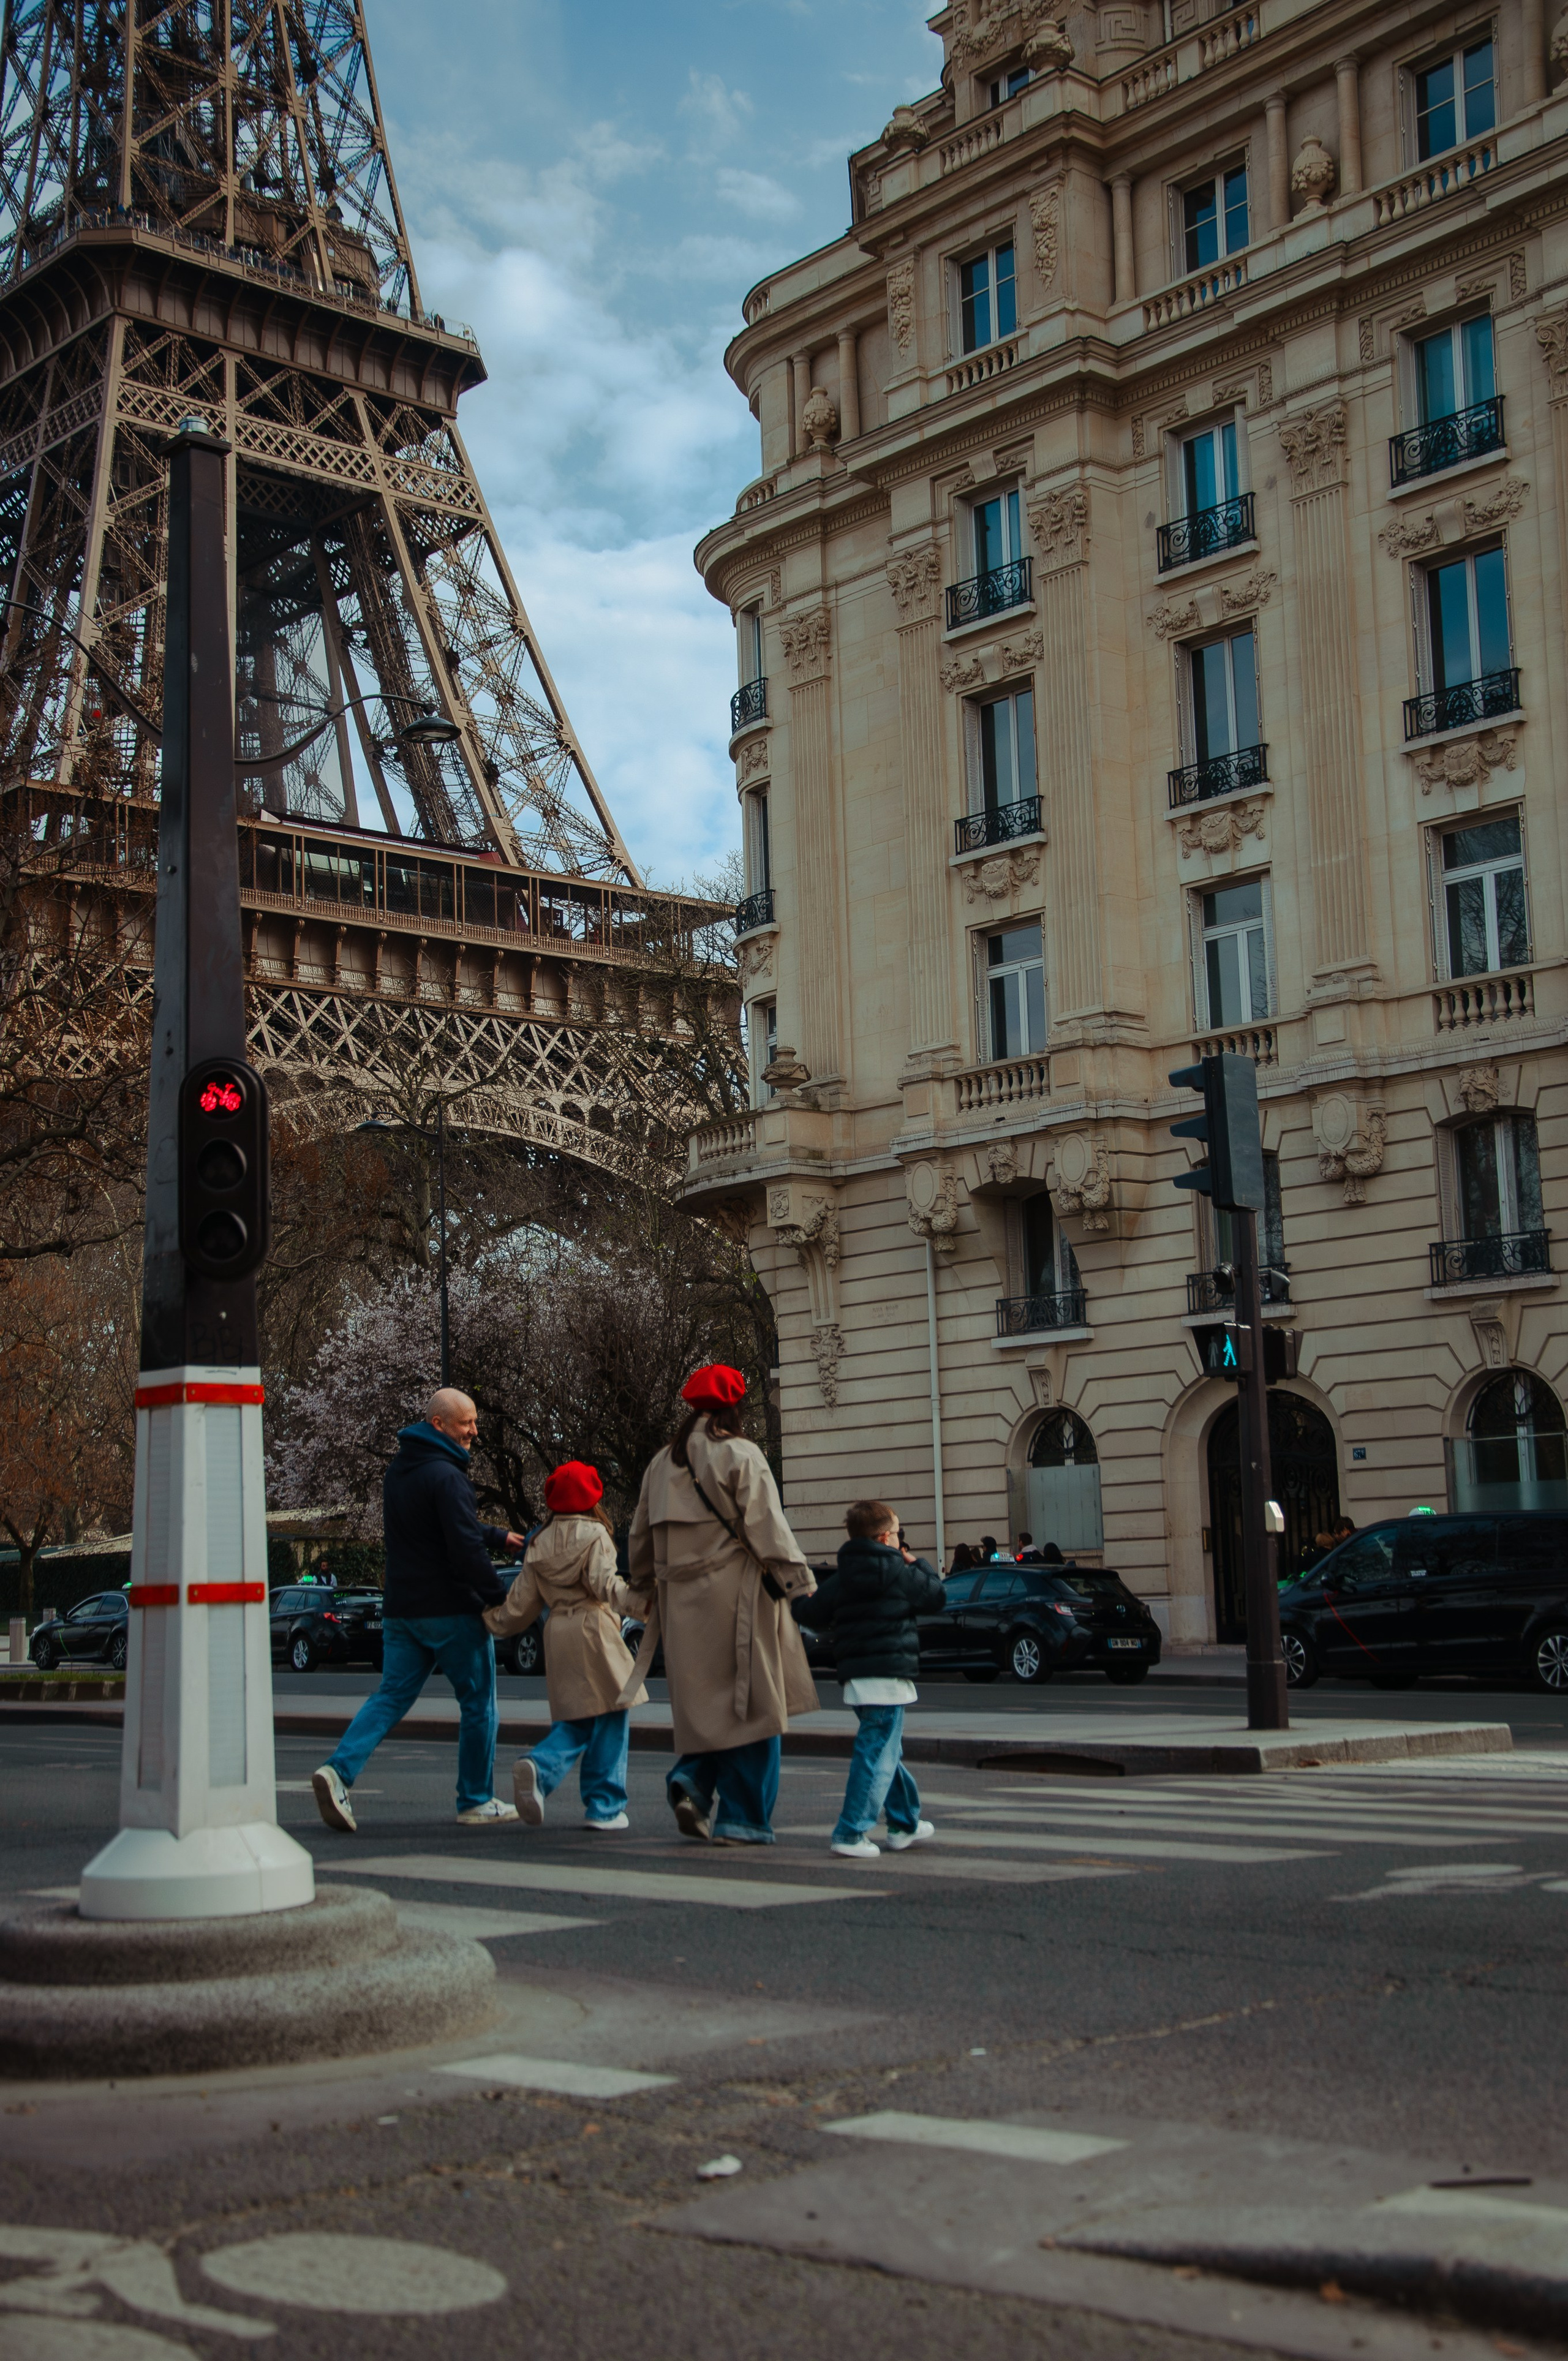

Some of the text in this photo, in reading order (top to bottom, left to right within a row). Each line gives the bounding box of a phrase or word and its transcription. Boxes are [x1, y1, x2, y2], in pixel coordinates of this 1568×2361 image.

[298, 964, 326, 976] BARRAL
[341, 970, 366, 982] DE DION
[537, 998, 559, 1009] ORIOLIS
